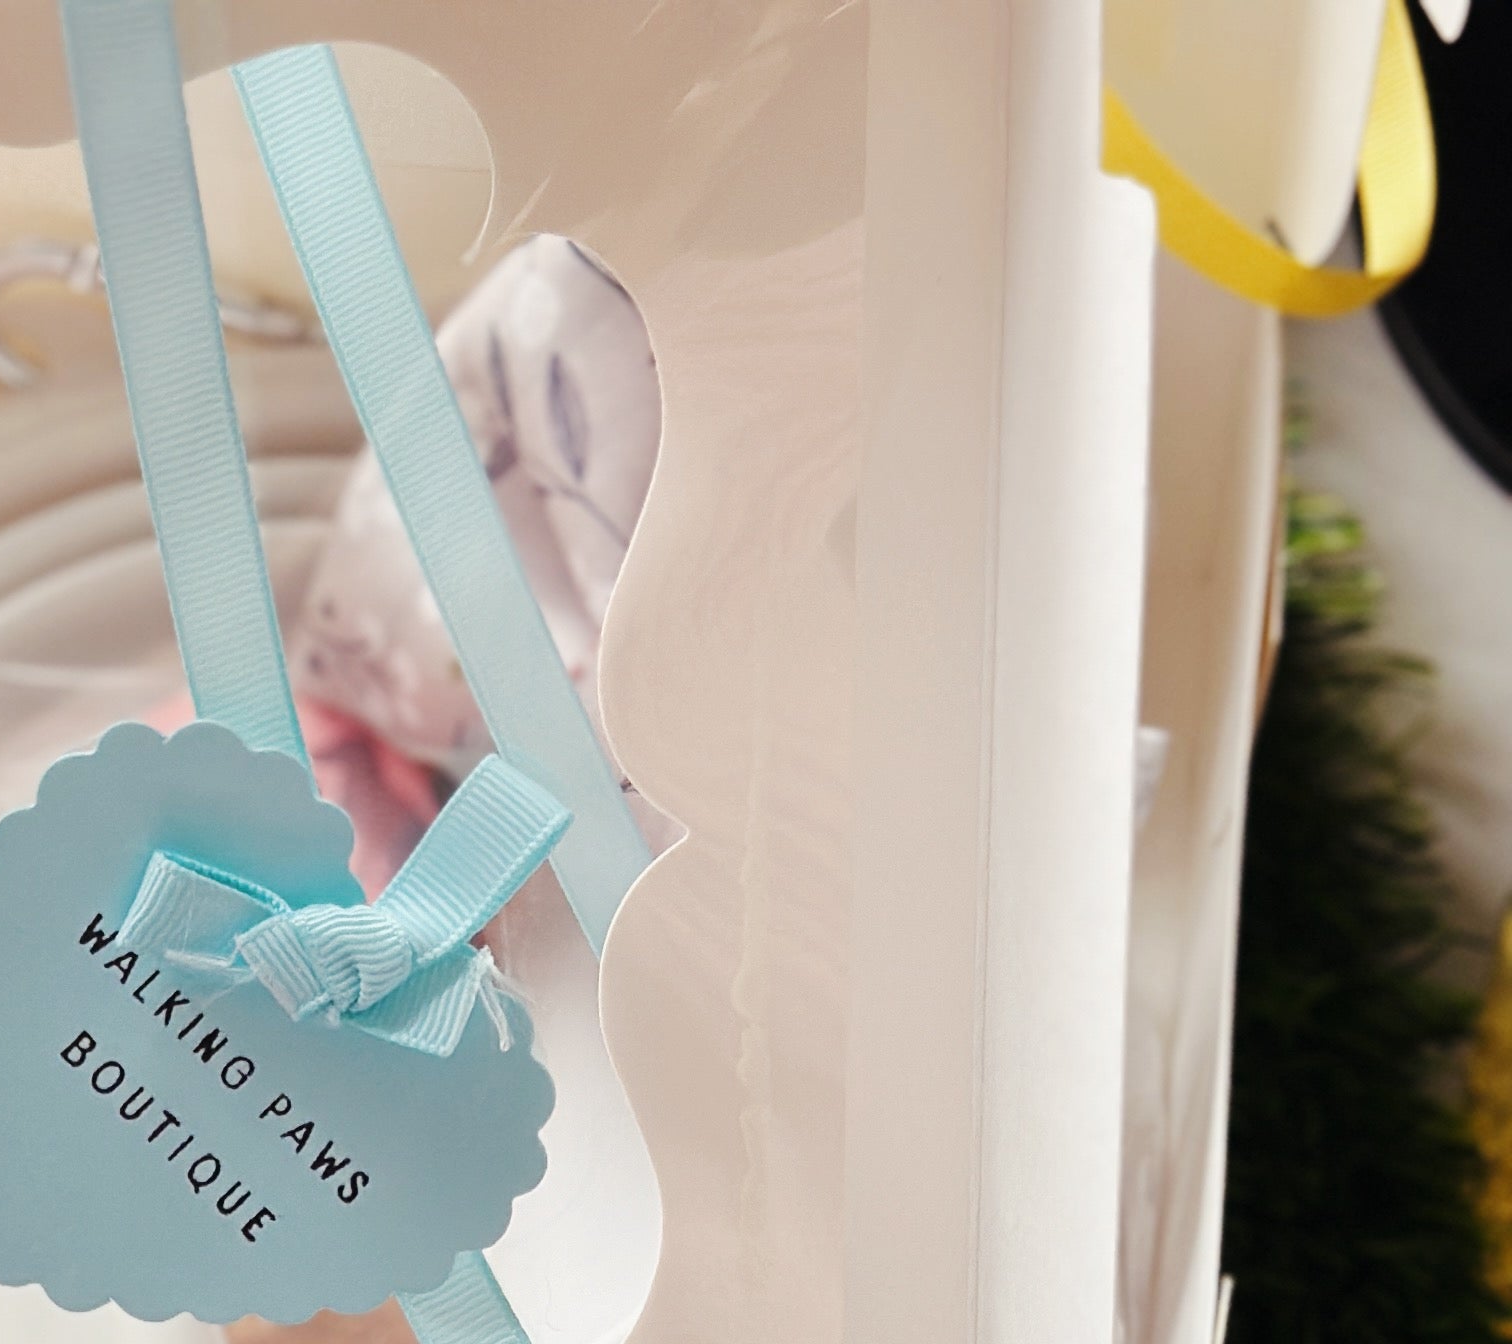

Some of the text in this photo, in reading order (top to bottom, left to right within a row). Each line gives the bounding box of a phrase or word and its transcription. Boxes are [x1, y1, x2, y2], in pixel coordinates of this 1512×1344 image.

[59, 1030, 276, 1243] BOUTIQUE
[78, 912, 370, 1205] WALKING PAWS
